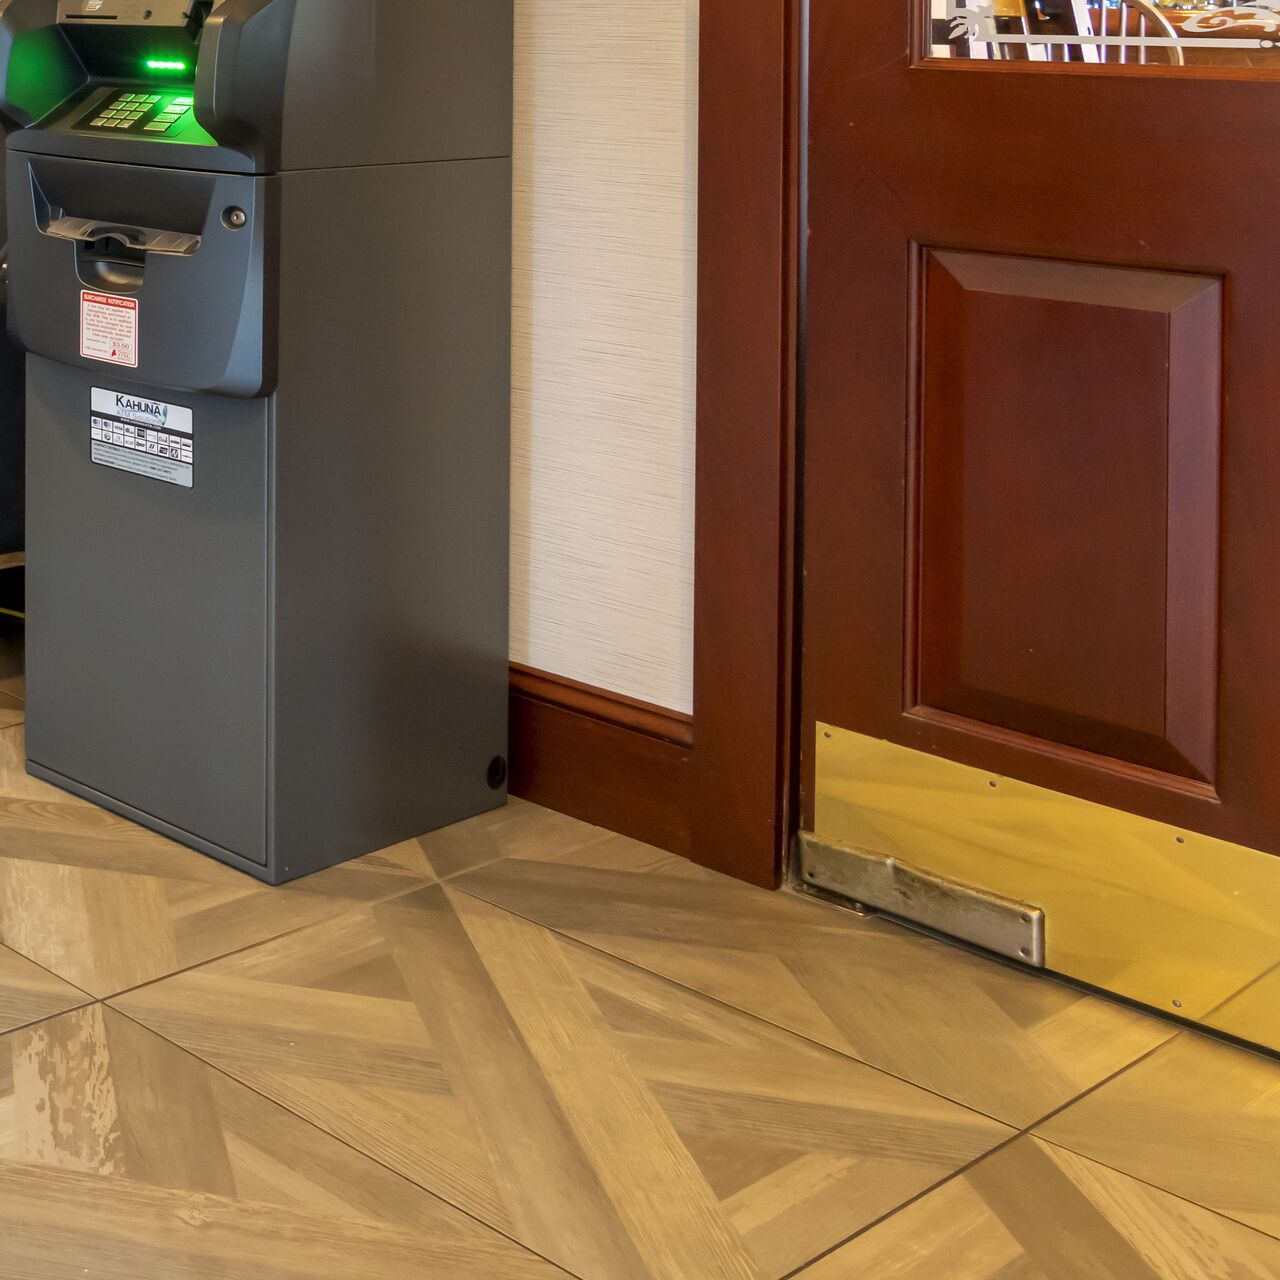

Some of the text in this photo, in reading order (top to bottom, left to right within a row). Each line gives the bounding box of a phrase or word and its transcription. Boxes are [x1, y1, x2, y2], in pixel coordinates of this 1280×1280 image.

[84, 293, 135, 308] SURCHARGE NOTIFICATION
[112, 341, 130, 350] $3.00
[116, 394, 162, 417] KAHUNA
[116, 409, 131, 418] ATM
